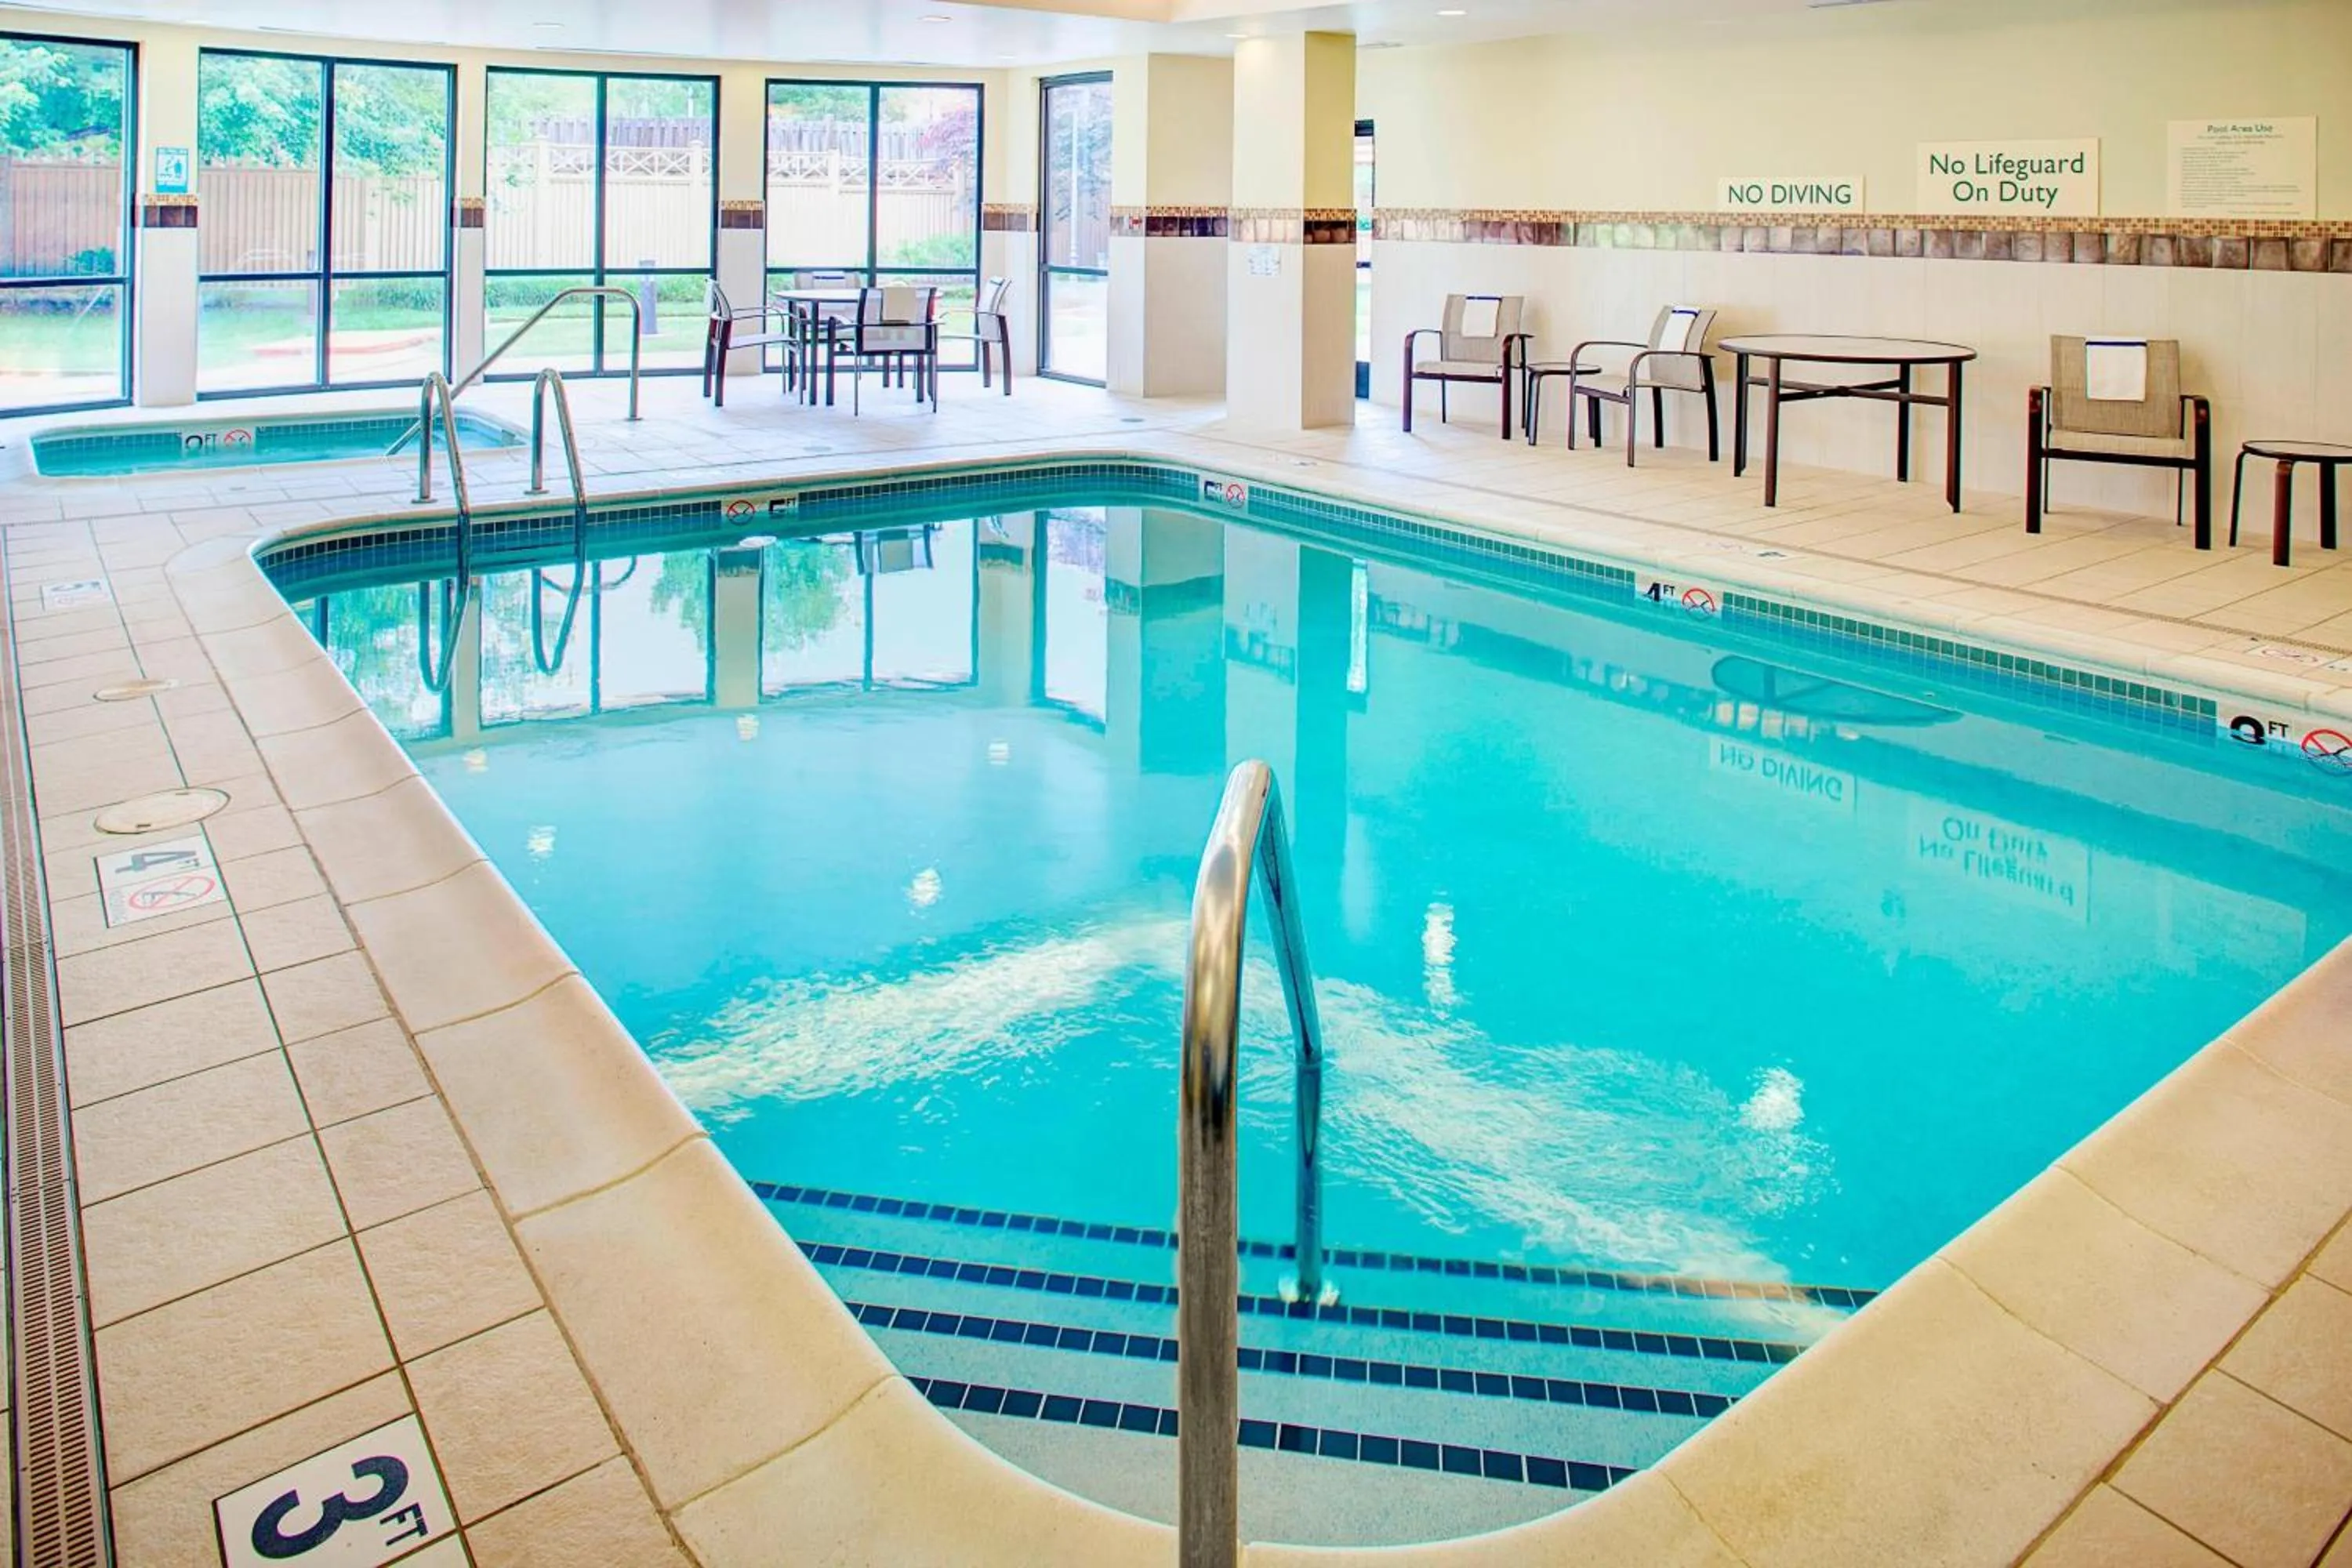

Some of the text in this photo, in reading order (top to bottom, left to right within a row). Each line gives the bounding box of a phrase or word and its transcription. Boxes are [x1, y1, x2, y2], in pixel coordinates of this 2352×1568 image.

[1929, 151, 2085, 181] No Lifeguard
[1728, 183, 1852, 204] NO DIVING
[1953, 180, 2059, 209] On Duty
[1663, 584, 1675, 596] FT
[2268, 720, 2288, 738] FT
[114, 850, 197, 873] 4
[251, 1455, 429, 1559] 3 FT
